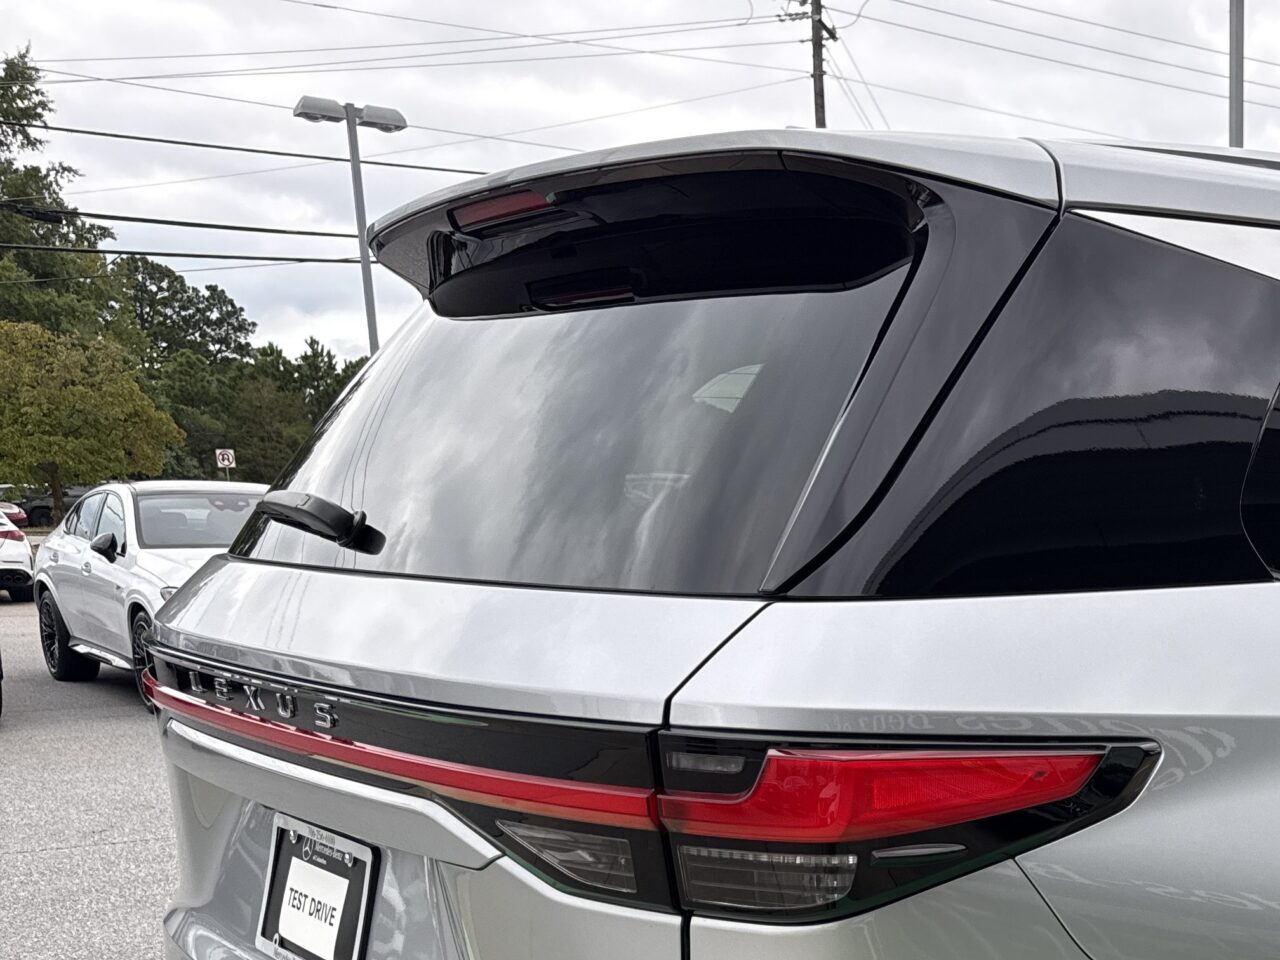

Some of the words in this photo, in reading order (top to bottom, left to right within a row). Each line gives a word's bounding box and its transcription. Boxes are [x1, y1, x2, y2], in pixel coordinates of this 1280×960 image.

[189, 670, 339, 729] LEXUS
[287, 887, 309, 913] TEST
[308, 897, 337, 927] DRIVE
